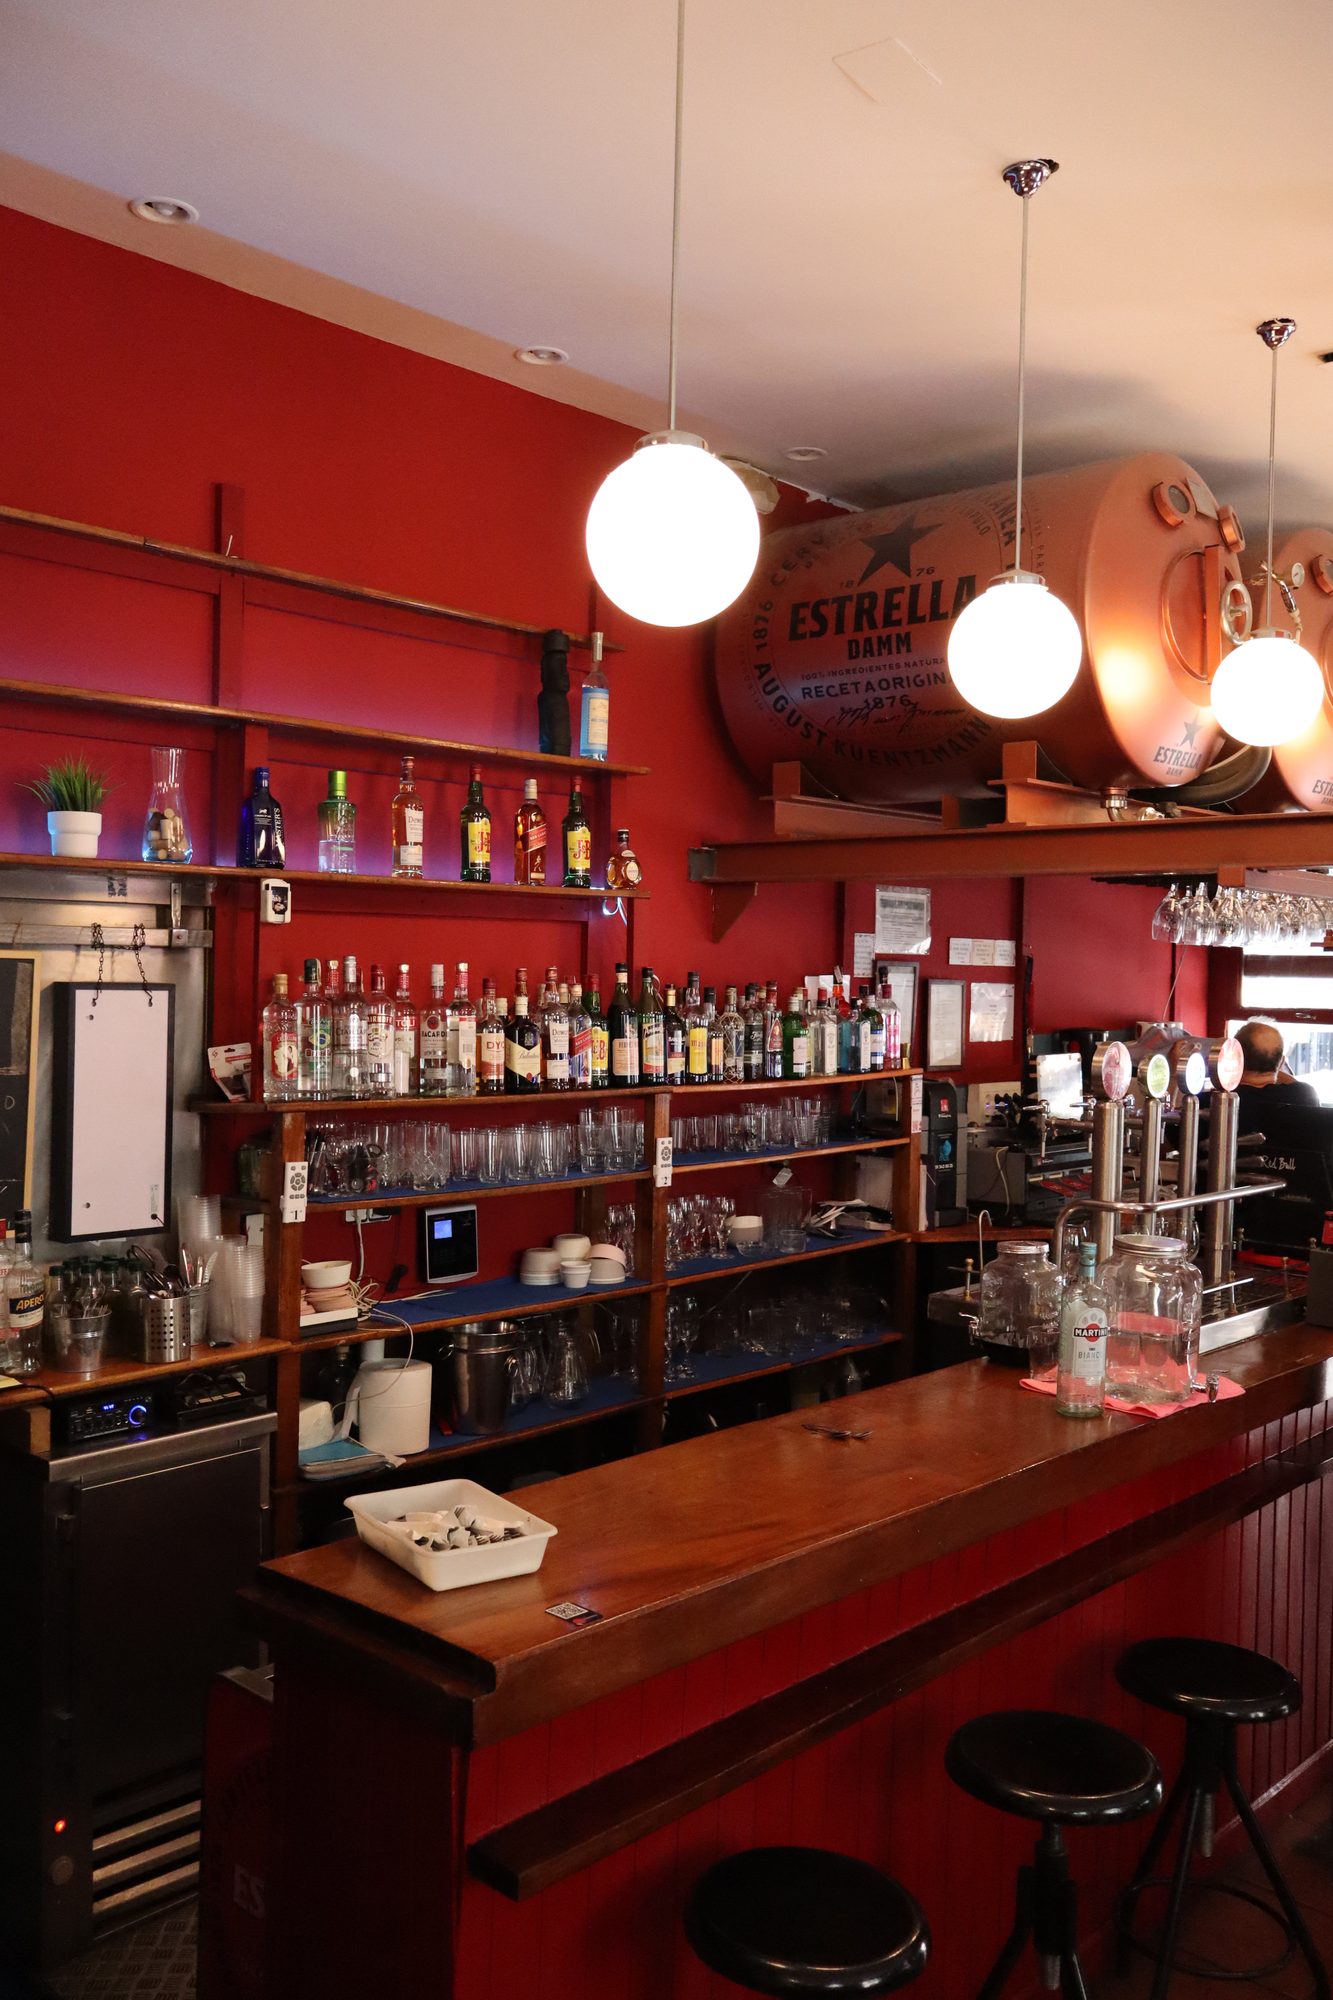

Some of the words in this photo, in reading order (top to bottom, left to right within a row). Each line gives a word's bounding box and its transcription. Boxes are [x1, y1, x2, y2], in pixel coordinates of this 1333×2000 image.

[916, 566, 935, 577] 76
[788, 574, 977, 642] ESTRELLA
[752, 601, 774, 650] 1876
[847, 631, 913, 661] DAMM
[828, 662, 902, 677] INGREDIENTES
[903, 657, 947, 669] NATURA
[754, 663, 828, 747] AUGUST
[1153, 746, 1203, 771] ESTRELLA
[396, 1018, 415, 1027] TOLI
[421, 1030, 447, 1038] BACARD
[16, 1293, 45, 1311] APERO
[1078, 1351, 1100, 1359] BIANC
